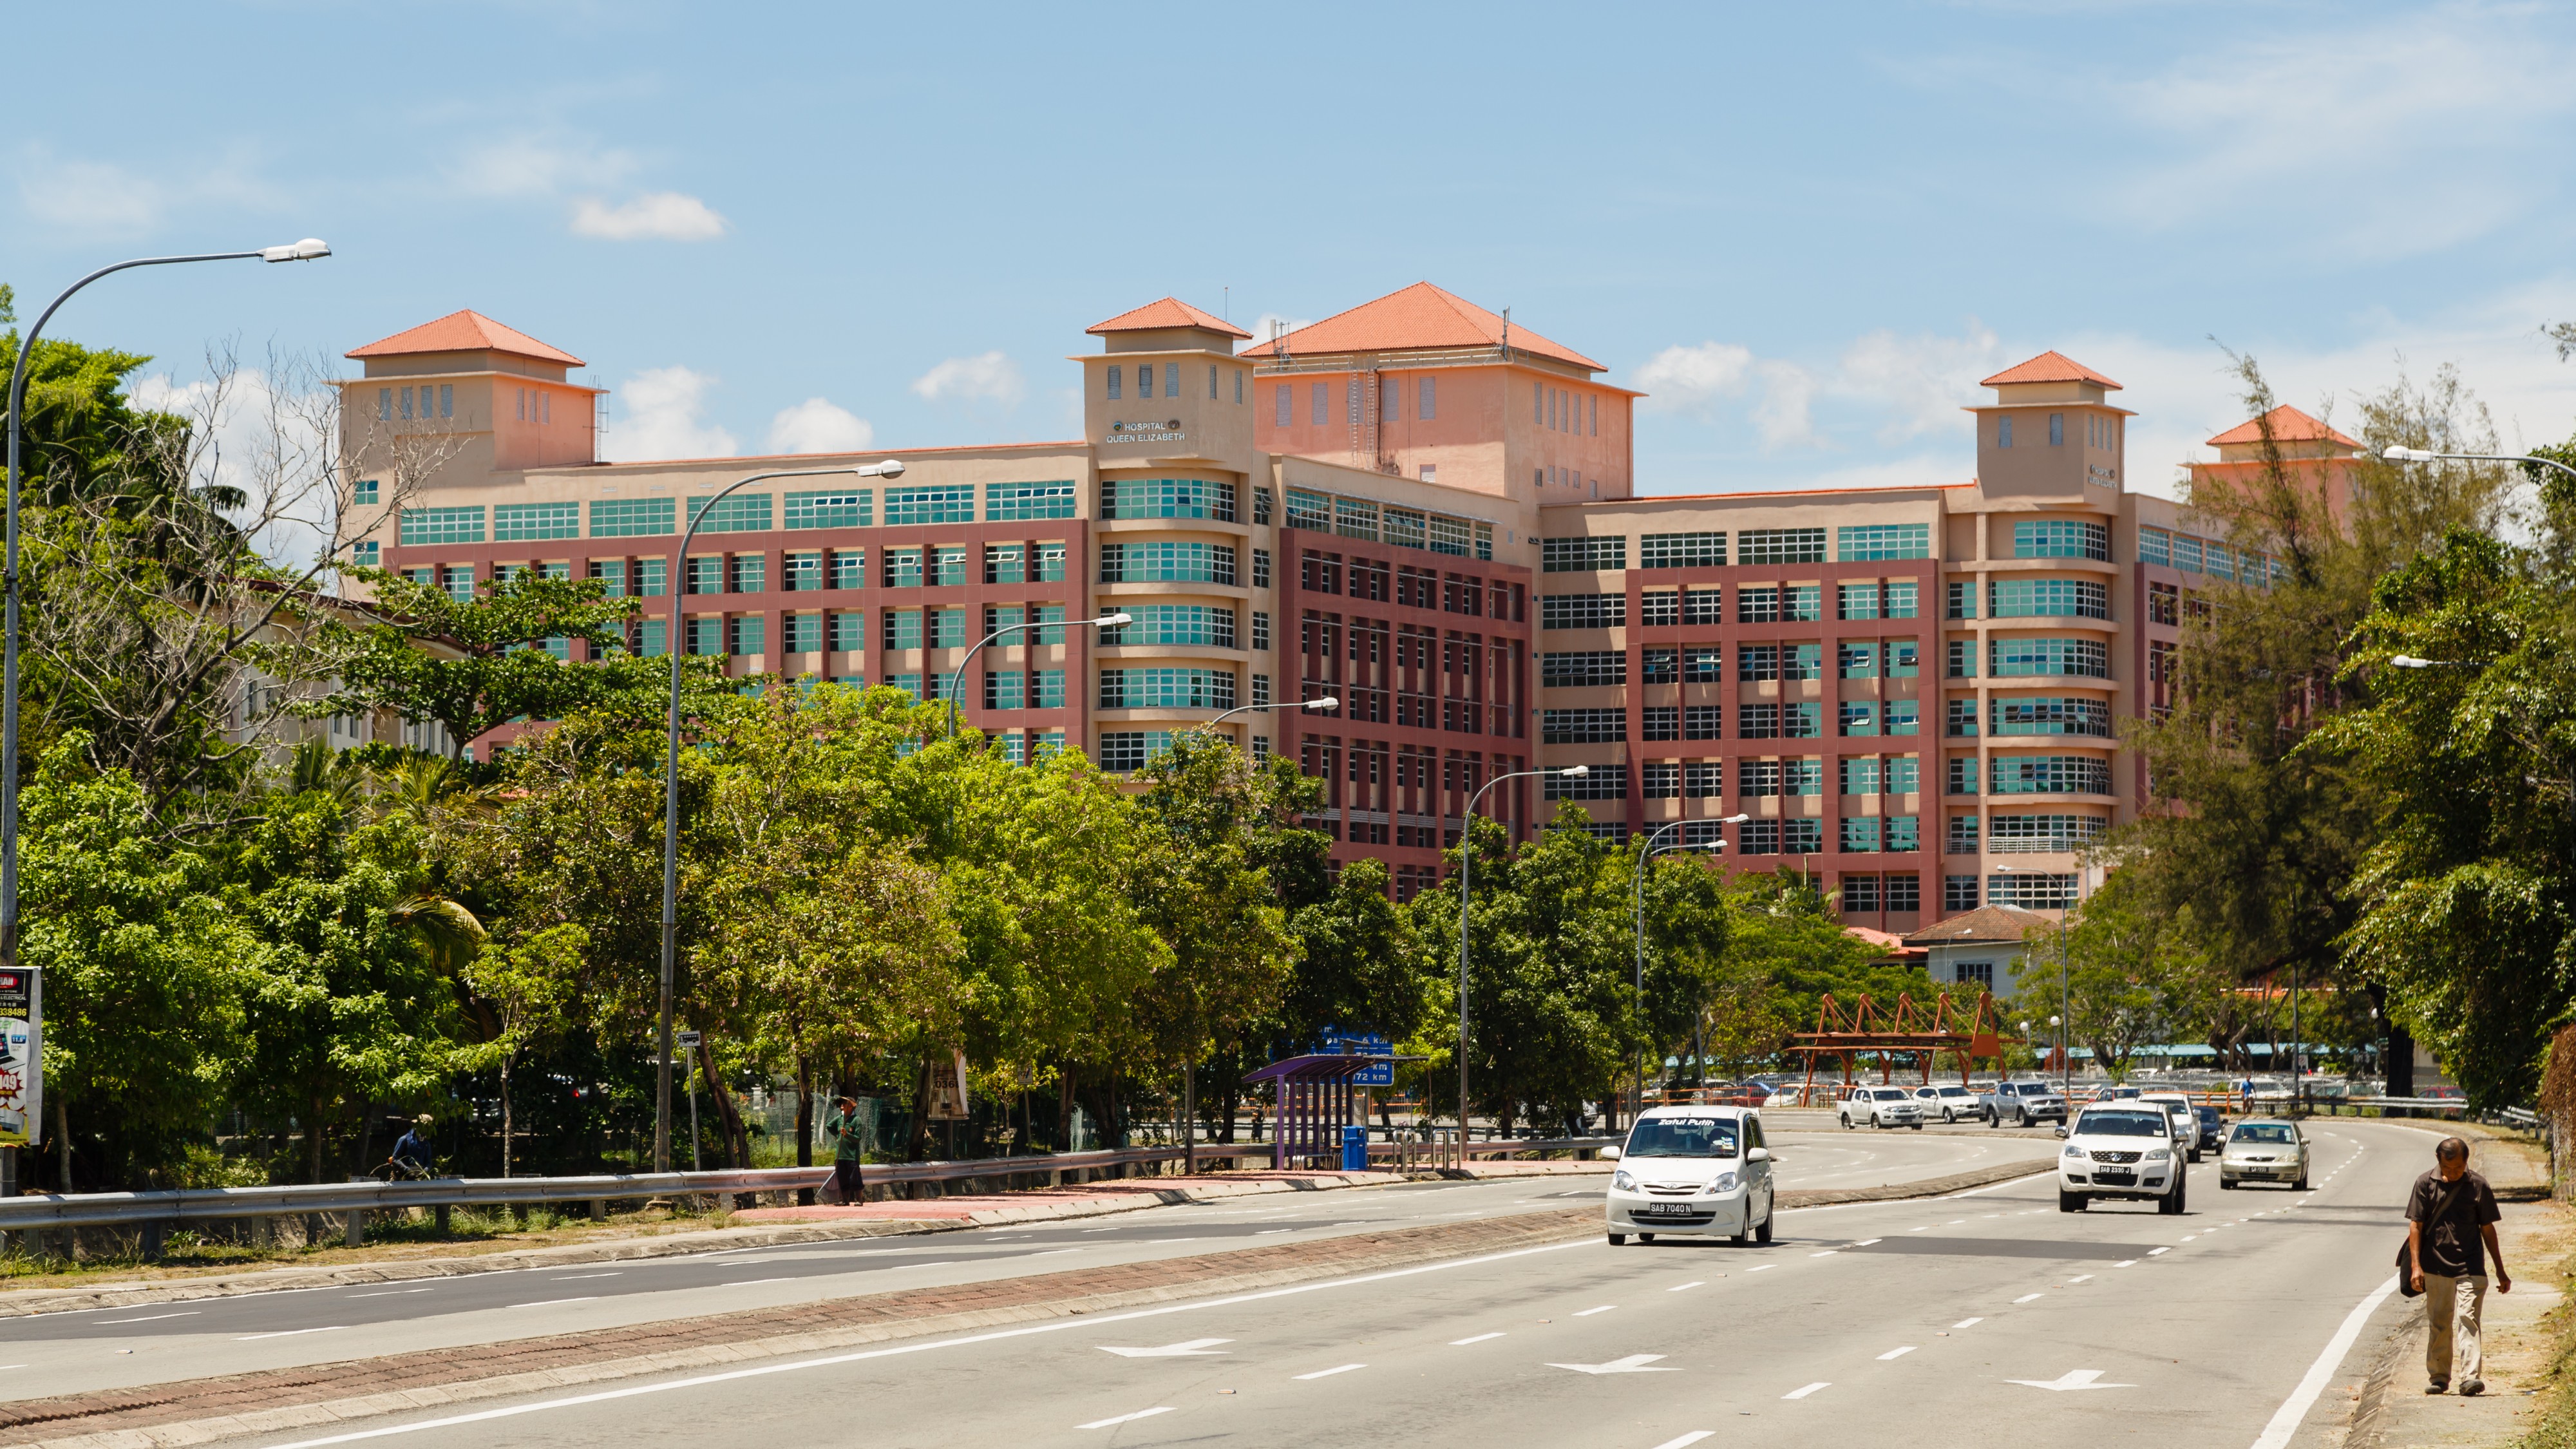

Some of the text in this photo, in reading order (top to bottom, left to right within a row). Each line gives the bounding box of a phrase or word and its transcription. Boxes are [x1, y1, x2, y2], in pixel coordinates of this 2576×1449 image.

[1124, 422, 1166, 431] HOSPITAL
[1106, 433, 1185, 444] QUEEN ELIZABETH
[1666, 1204, 1685, 1213] 7040
